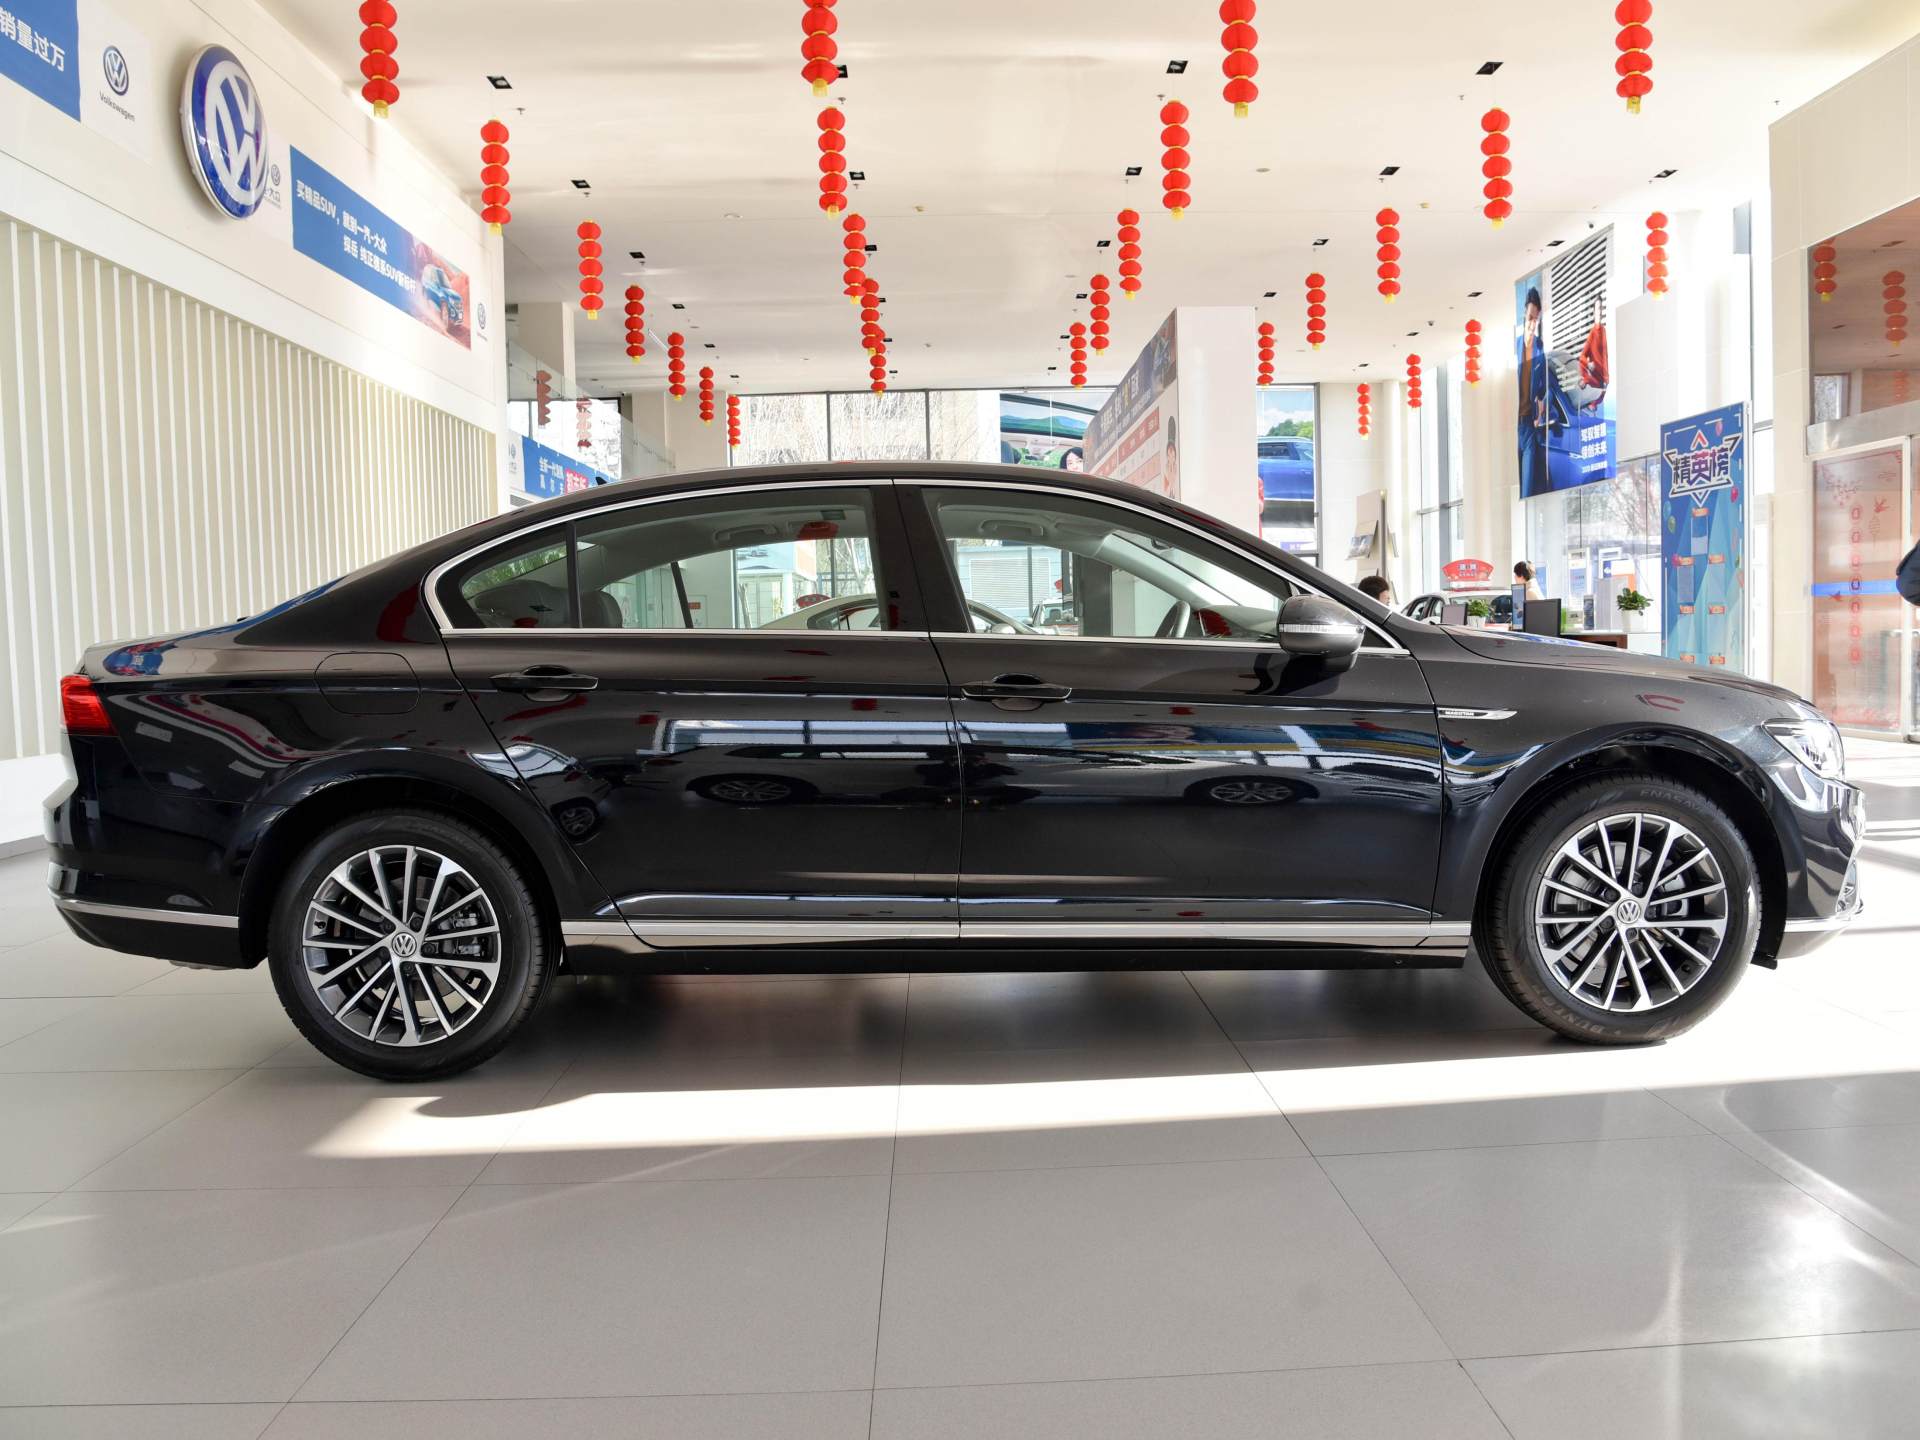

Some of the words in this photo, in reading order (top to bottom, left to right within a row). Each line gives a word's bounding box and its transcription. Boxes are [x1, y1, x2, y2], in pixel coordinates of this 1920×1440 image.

[0, 6, 65, 72] 销量过万
[99, 92, 136, 122] Volkswagen
[1673, 446, 1729, 486] 精英榜
